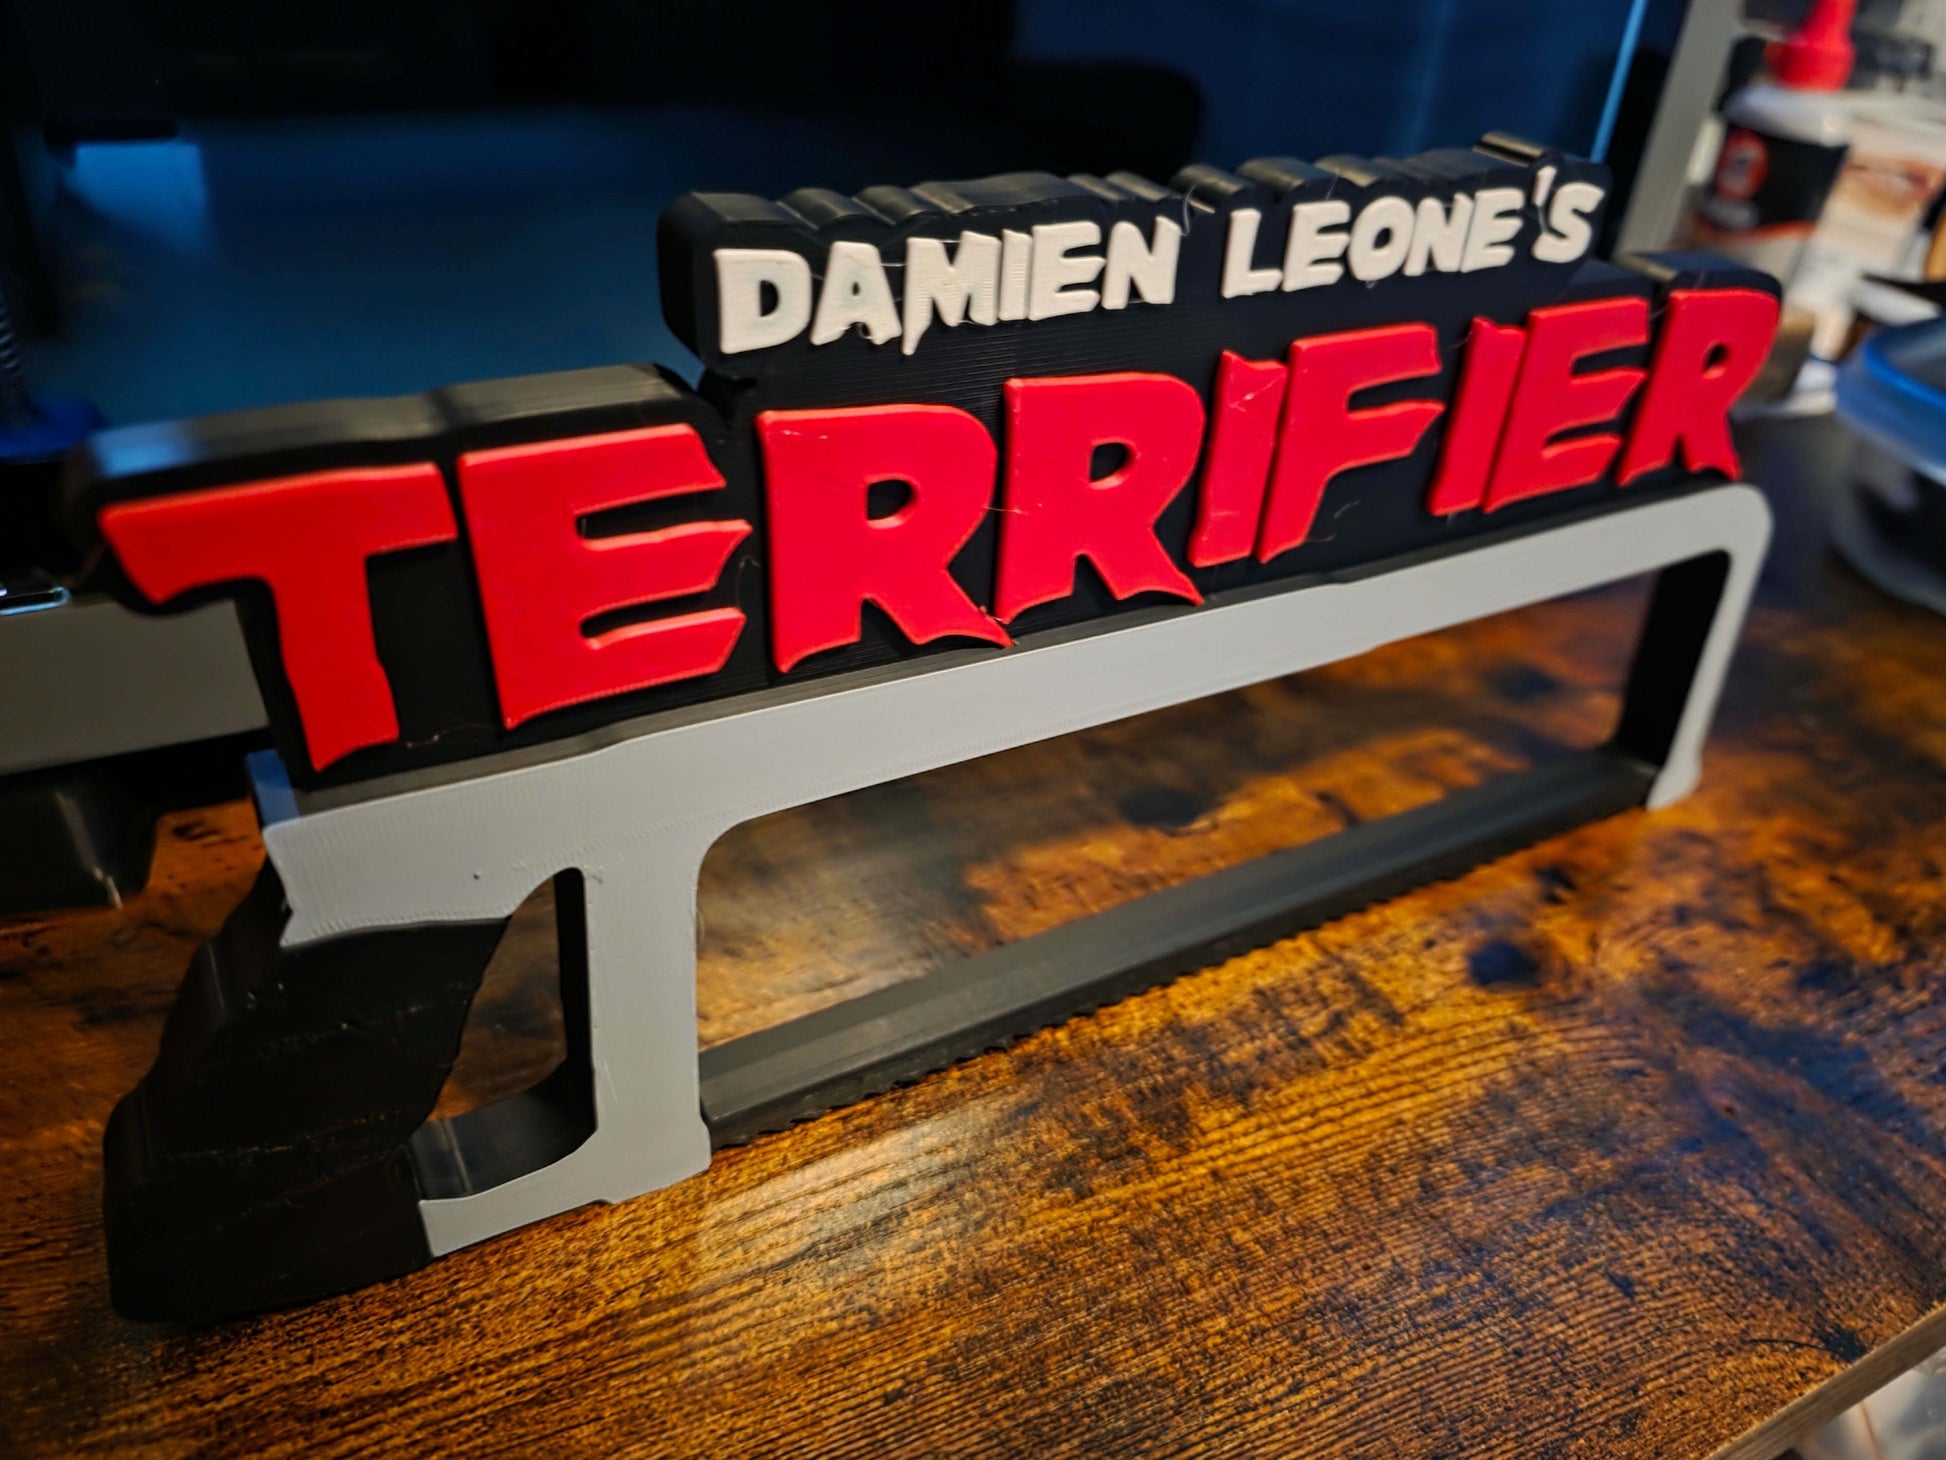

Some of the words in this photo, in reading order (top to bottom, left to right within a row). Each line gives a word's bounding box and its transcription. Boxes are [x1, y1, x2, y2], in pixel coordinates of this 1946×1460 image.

[714, 214, 1182, 356] DAMIEN
[1222, 165, 1606, 299] LEONE'S
[100, 287, 1783, 772] TERRIFIER
